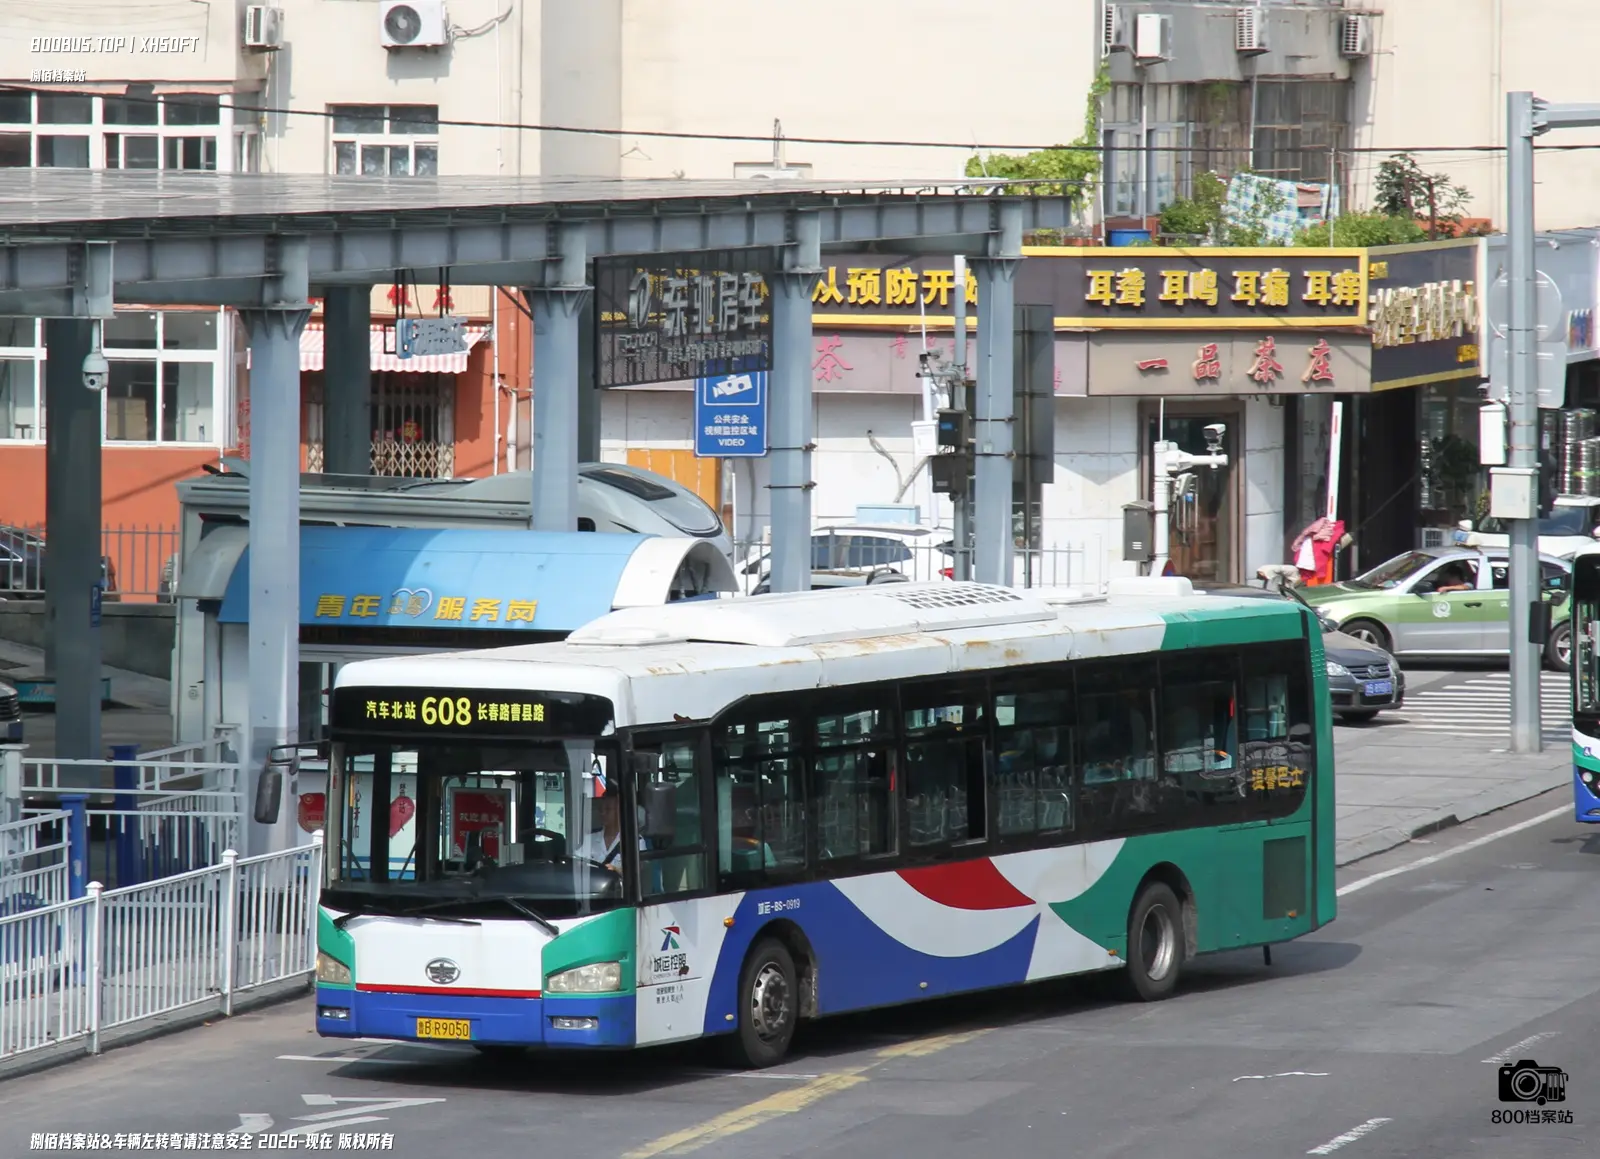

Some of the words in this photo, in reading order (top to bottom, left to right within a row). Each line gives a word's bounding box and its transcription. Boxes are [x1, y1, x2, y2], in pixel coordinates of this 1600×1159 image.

[1086, 267, 1146, 307] 耳聋
[1159, 268, 1218, 307] 耳鸣
[1231, 268, 1290, 307] 耳痛
[1303, 269, 1360, 307] 耳痒
[1135, 336, 1335, 383] 一品茶庄
[713, 414, 749, 424] 公共安全
[704, 426, 758, 436] 视频监控区域
[718, 438, 746, 446] VIDEO
[366, 701, 417, 720] 汽车北站
[421, 697, 472, 726] 608
[477, 703, 545, 722] 长春路曹县路
[653, 953, 687, 973] 城运控股
